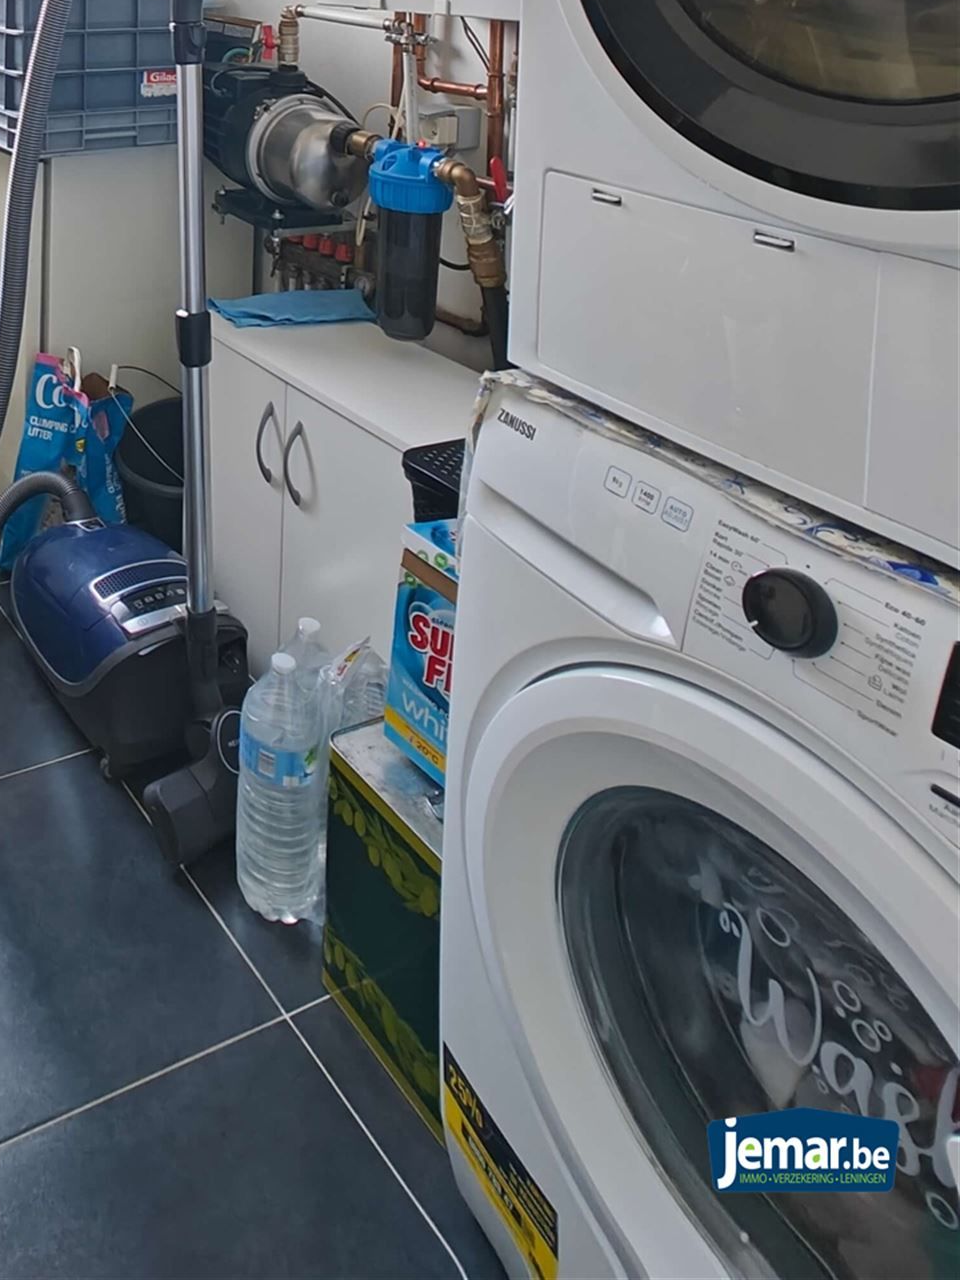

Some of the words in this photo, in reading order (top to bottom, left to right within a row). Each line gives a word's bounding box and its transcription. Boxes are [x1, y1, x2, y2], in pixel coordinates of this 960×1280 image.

[29, 415, 68, 433] CLUMPING
[497, 408, 537, 441] ZANUSSI
[27, 426, 53, 441] LITTER
[884, 602, 900, 614] Eco
[402, 691, 448, 741] whi
